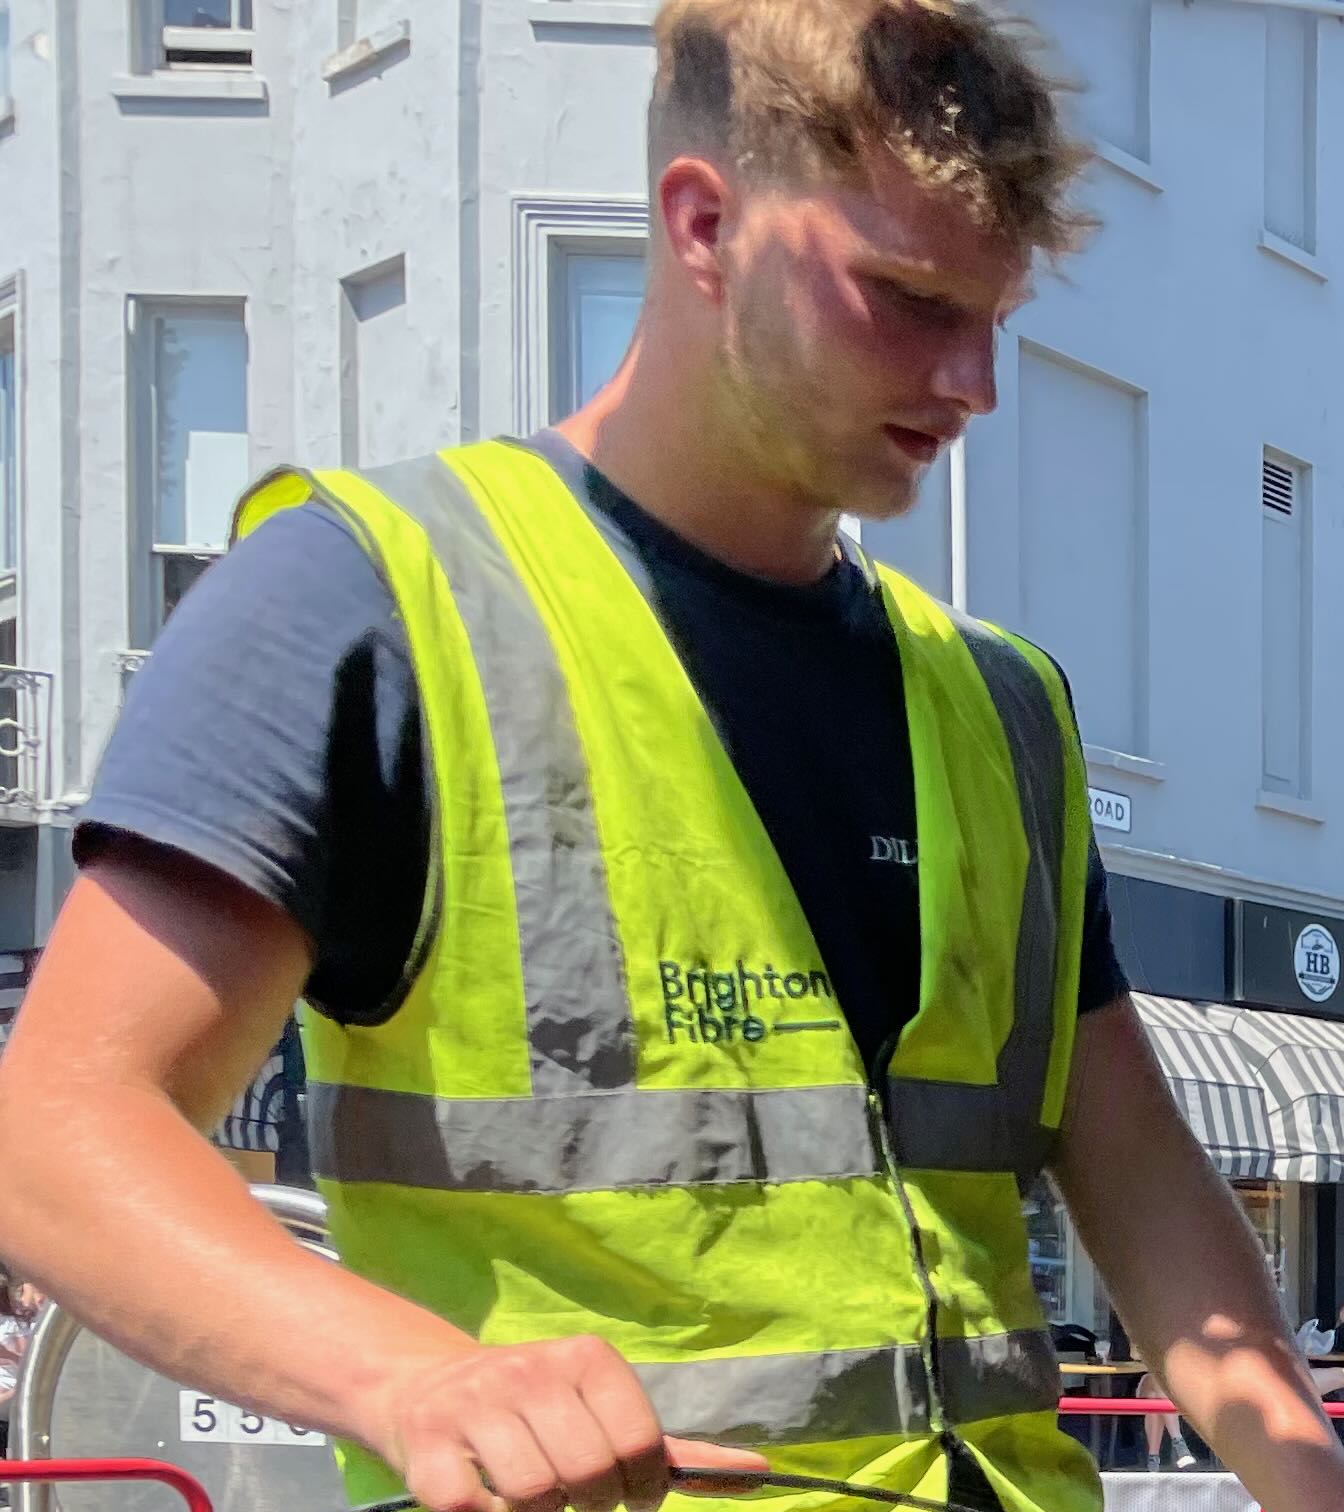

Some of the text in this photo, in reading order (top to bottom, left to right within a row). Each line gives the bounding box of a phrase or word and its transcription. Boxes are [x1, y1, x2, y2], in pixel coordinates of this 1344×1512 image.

[1090, 796, 1125, 821] OAD
[869, 835, 917, 865] DIL
[1305, 951, 1331, 975] HB
[659, 959, 834, 1012] Brighton
[665, 1001, 766, 1044] Fibre
[192, 1398, 309, 1436] 55
